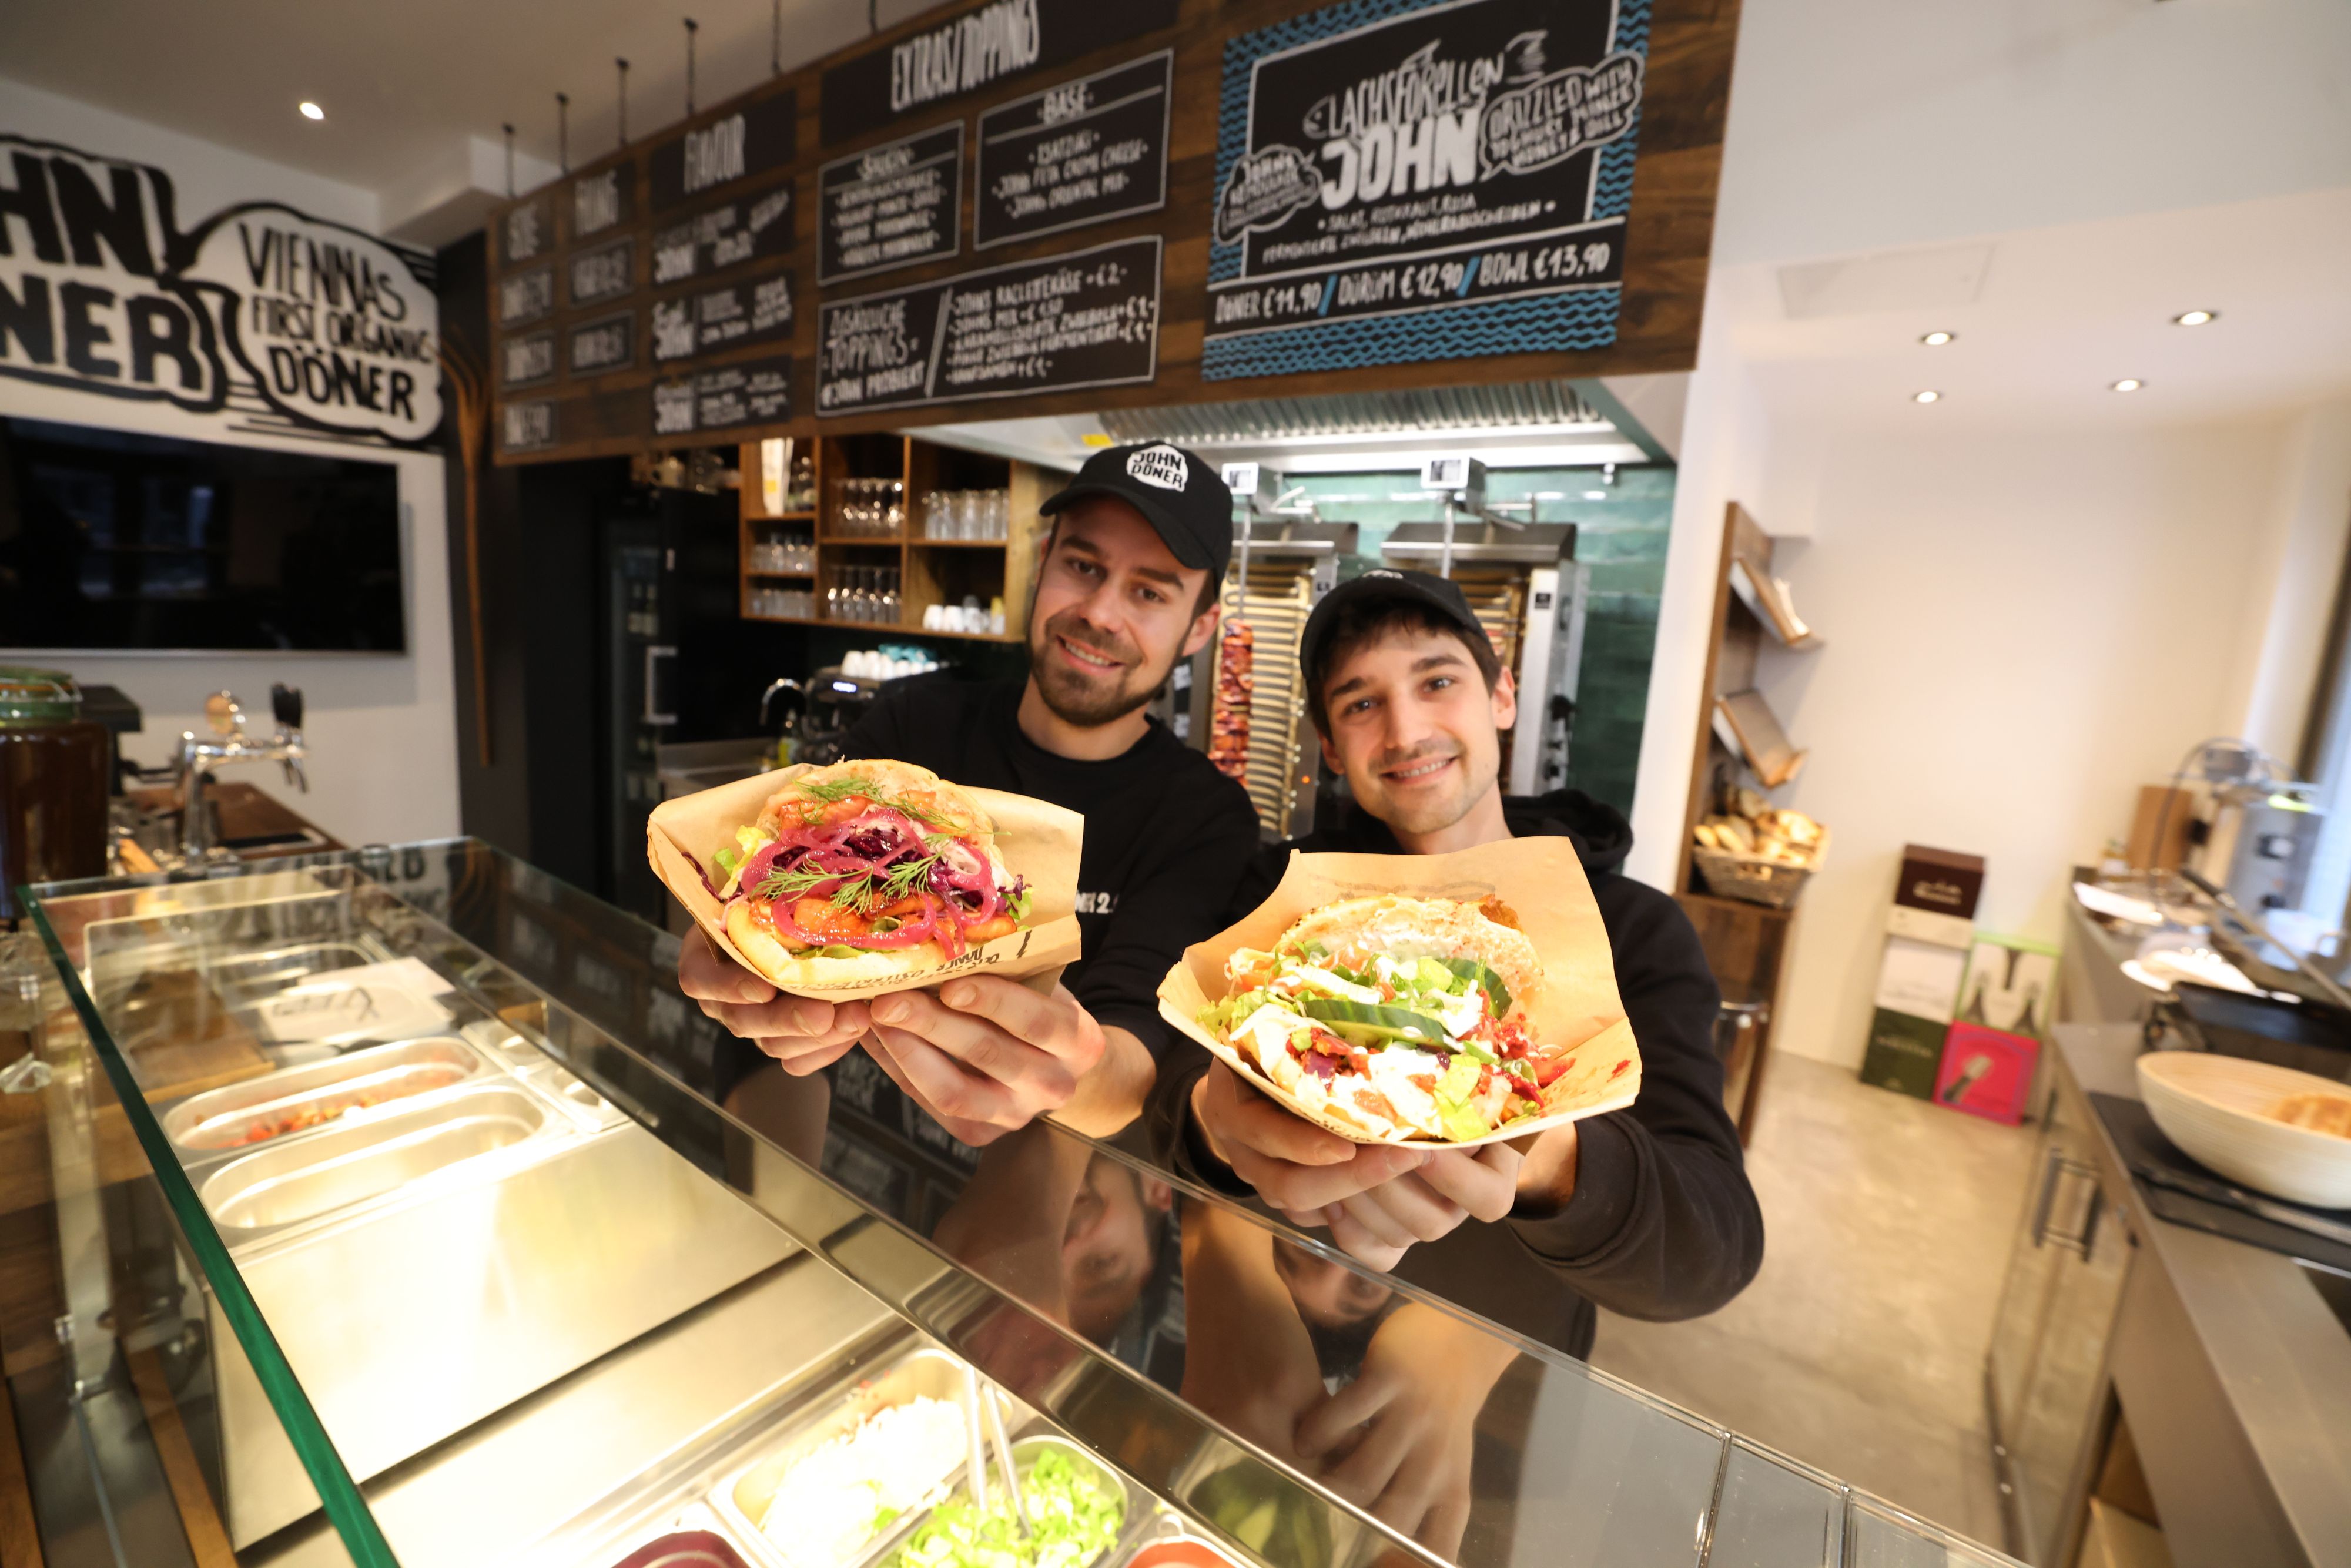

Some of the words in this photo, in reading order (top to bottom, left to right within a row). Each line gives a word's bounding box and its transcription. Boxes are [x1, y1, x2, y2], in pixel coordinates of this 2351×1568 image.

[1322, 106, 1482, 210] JOHN
[239, 221, 407, 323] VIENNAS
[1478, 249, 1529, 287] BOWL
[267, 343, 416, 424] DÖNER
[1133, 451, 1181, 471] JOHN
